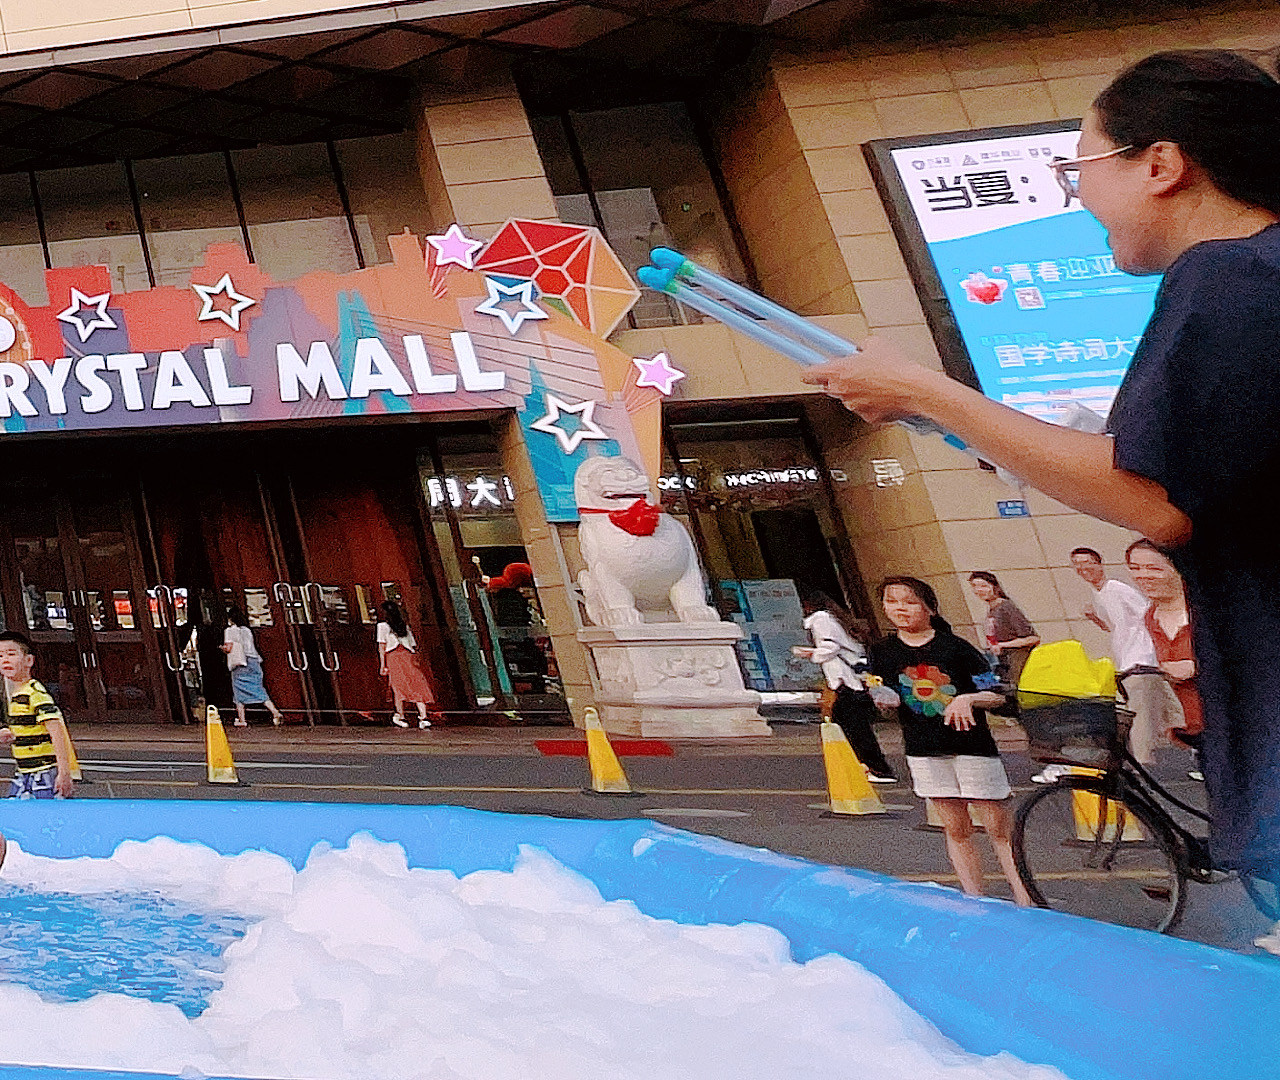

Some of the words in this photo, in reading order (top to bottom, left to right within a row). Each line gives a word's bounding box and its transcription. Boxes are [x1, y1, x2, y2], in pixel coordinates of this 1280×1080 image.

[276, 332, 506, 402] MALL
[994, 335, 1143, 368] 国学诗词大
